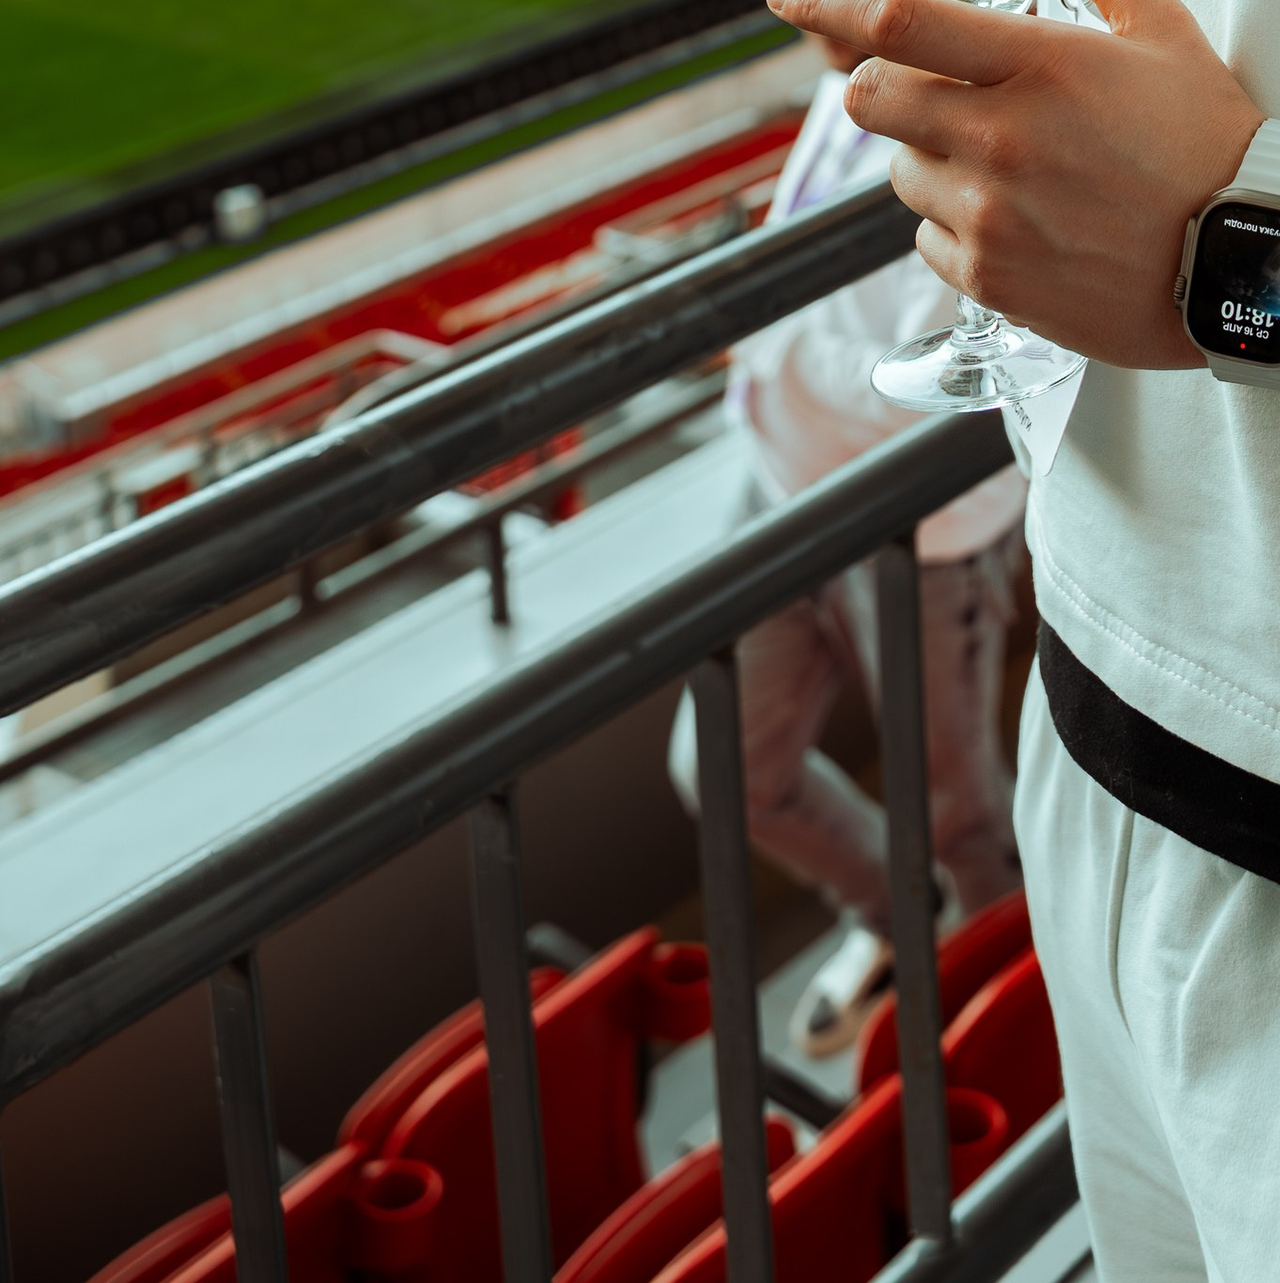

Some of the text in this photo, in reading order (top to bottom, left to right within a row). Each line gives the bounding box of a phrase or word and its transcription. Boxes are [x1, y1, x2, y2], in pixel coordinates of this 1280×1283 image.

[1223, 218, 1258, 232] ПОГОДЫ
[1221, 300, 1275, 328] 18:10
[1244, 326, 1254, 336] 16
